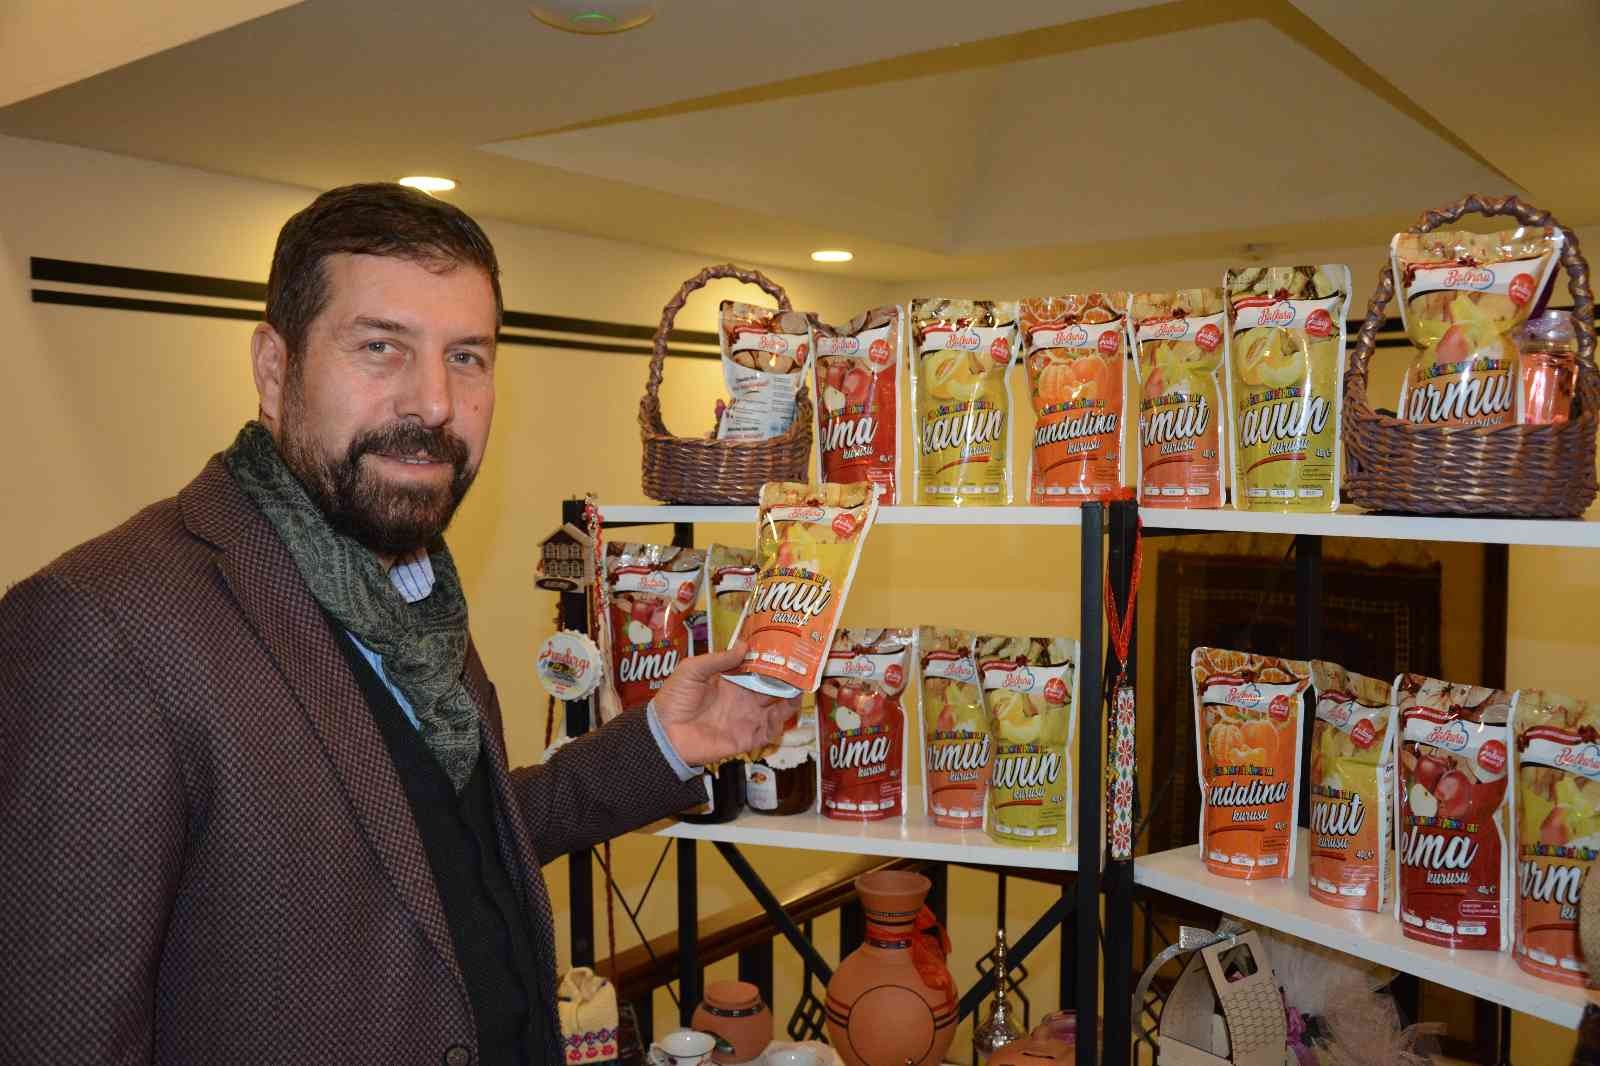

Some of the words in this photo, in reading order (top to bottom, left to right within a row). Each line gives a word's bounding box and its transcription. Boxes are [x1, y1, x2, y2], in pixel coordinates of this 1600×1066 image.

[1408, 370, 1514, 425] armut
[1141, 397, 1210, 448] rmut
[1241, 396, 1331, 448] avun
[752, 579, 832, 616] rmut
[619, 649, 681, 683] elma
[829, 735, 891, 769] elma
[992, 751, 1062, 789] avun
[1209, 779, 1289, 808] ndalina
[1232, 809, 1270, 823] kurusu
[1311, 793, 1367, 836] mut
[1400, 825, 1479, 870] elma
[1426, 870, 1471, 885] kurusu
[1520, 861, 1584, 906] arm
